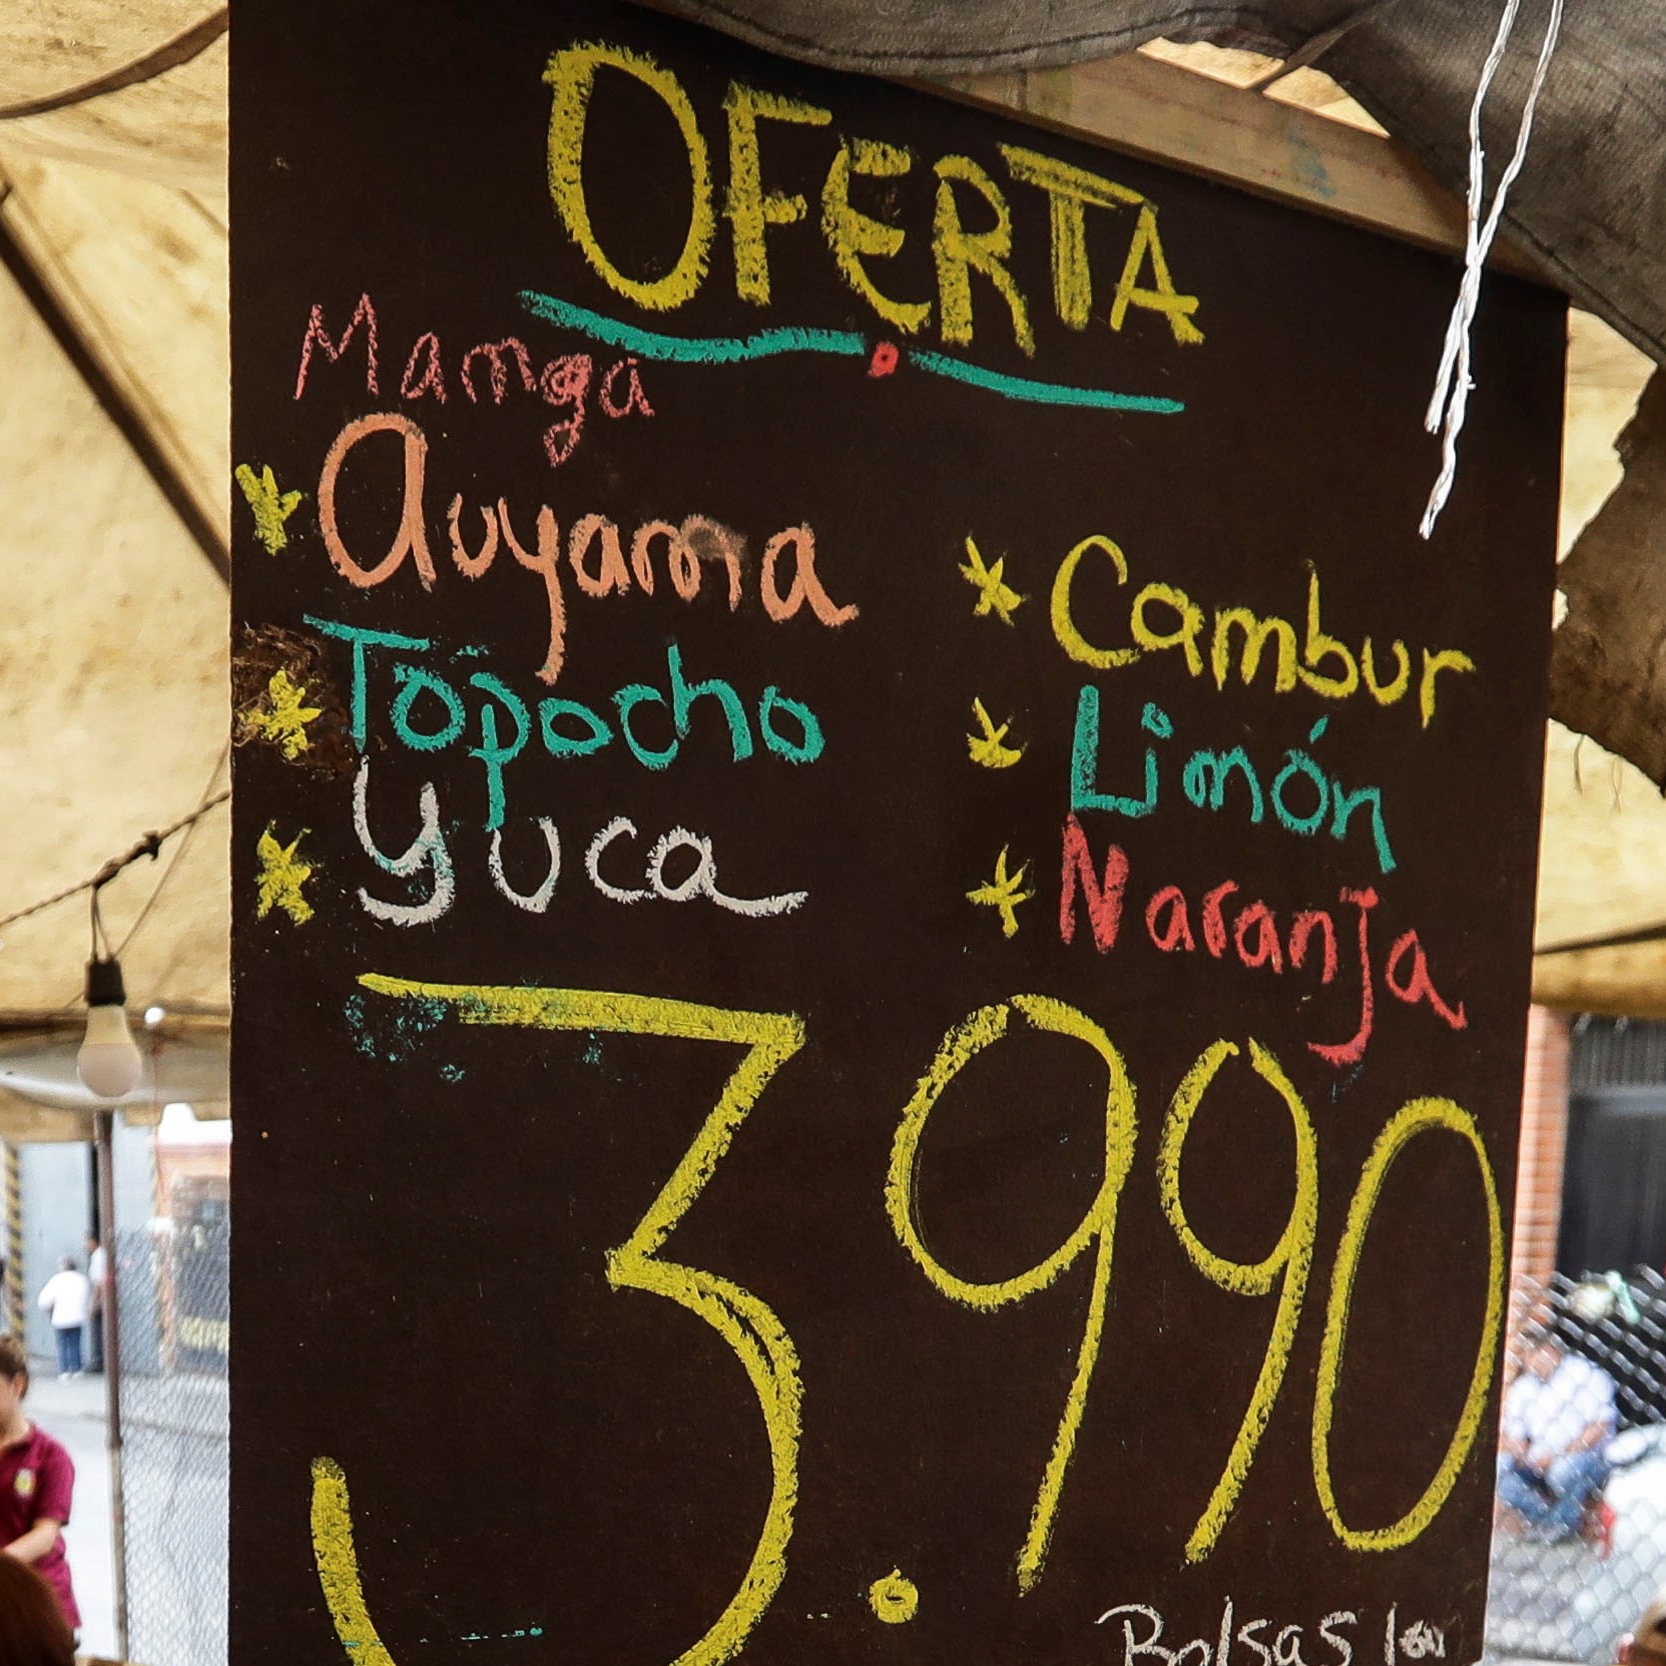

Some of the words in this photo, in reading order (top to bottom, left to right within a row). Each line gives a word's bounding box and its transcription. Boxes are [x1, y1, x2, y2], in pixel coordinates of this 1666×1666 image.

[541, 42, 1205, 356] OFERTA
[293, 291, 656, 468] Manga
[317, 412, 860, 685] Auyama
[1050, 534, 1475, 728] Cambur
[303, 614, 826, 830] Topocho
[1070, 684, 1396, 872] Limón
